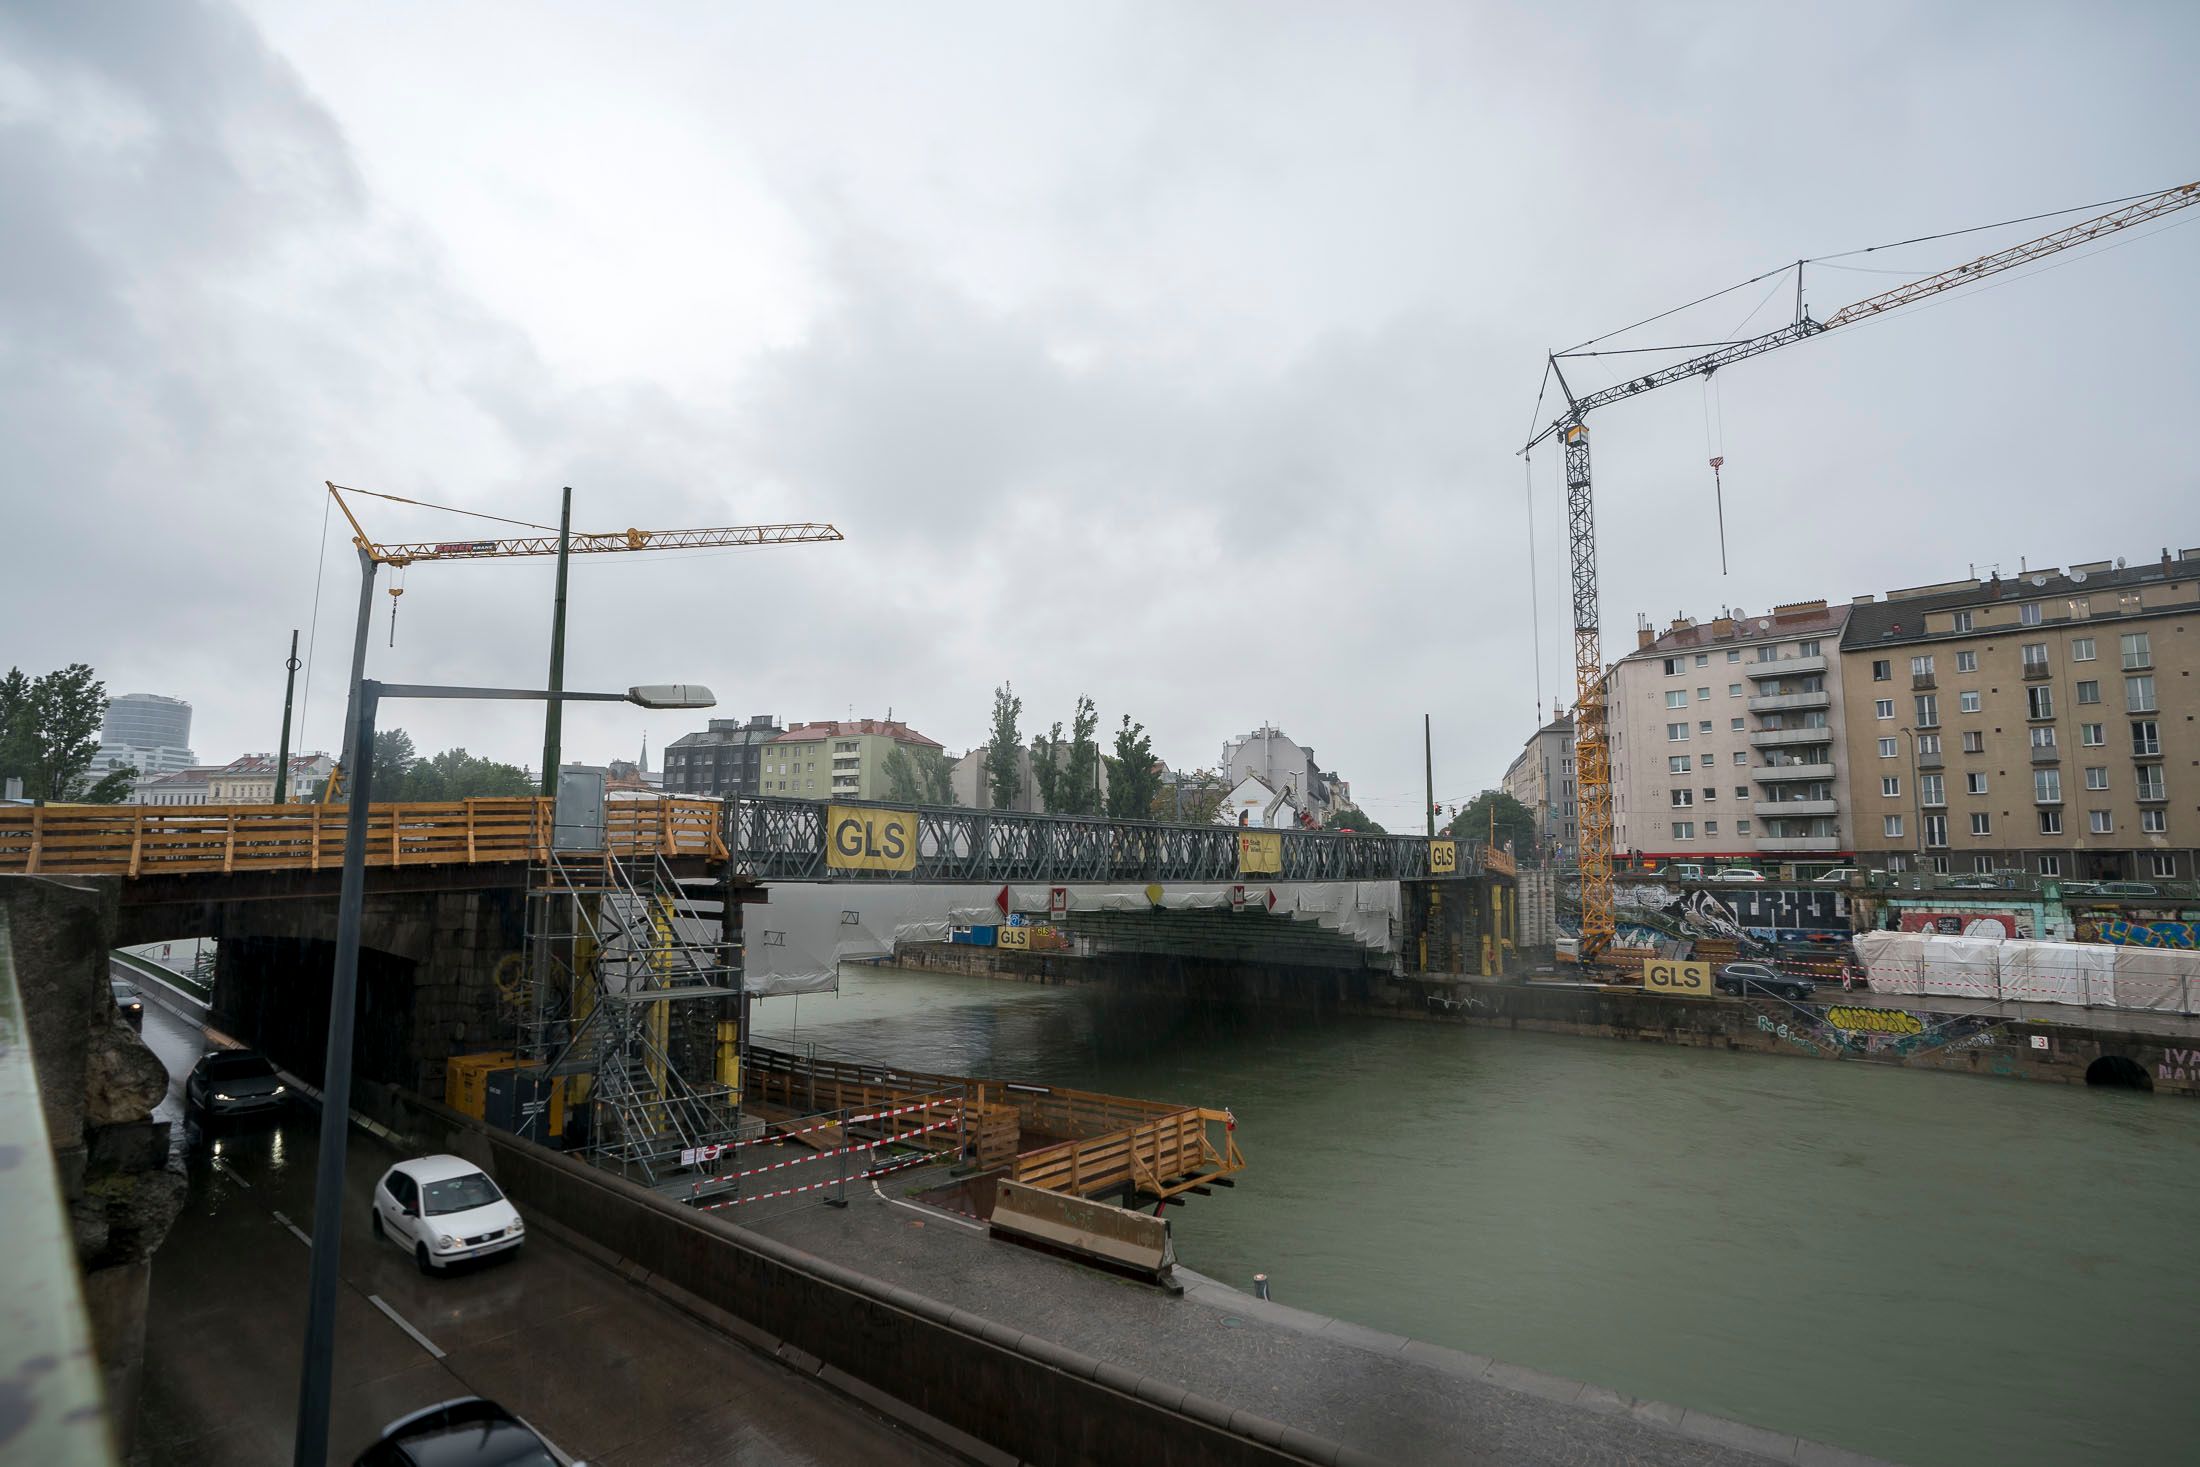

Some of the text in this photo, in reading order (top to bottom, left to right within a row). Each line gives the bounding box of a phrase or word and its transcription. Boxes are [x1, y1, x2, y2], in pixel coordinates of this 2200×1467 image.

[836, 819, 905, 859] GLS
[1433, 847, 1453, 866] GLS
[1001, 931, 1026, 945] GLS
[1036, 927, 1050, 936] GLS
[1650, 966, 1701, 988] GLS
[2038, 1037, 2045, 1047] 3
